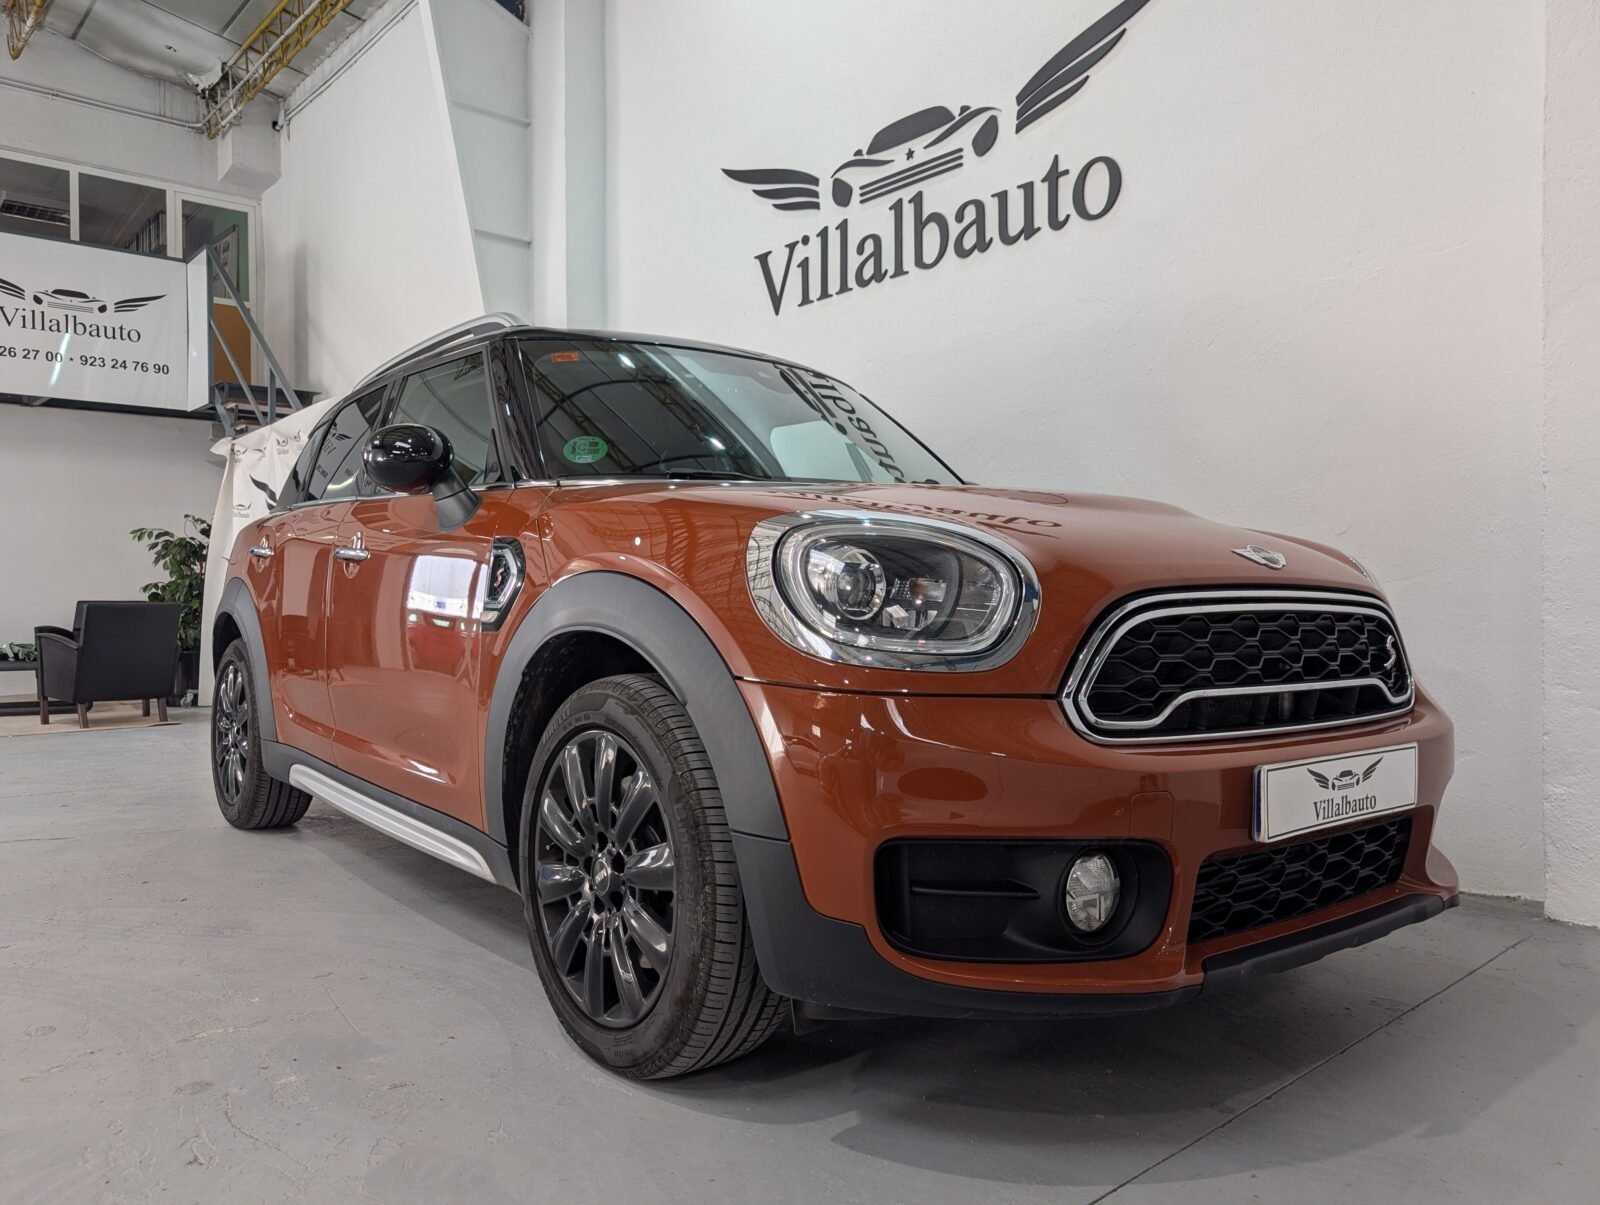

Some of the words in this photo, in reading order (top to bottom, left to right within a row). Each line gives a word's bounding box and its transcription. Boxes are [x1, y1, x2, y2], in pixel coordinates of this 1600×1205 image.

[754, 153, 1123, 316] Villalbauto
[0, 305, 142, 343] Villalbauto
[22, 348, 41, 361] 27
[45, 351, 64, 362] 00
[79, 355, 107, 368] 923
[111, 358, 128, 370] 24
[132, 361, 149, 373] 76
[153, 363, 170, 375] 90
[1313, 793, 1377, 822] Villalbauto
